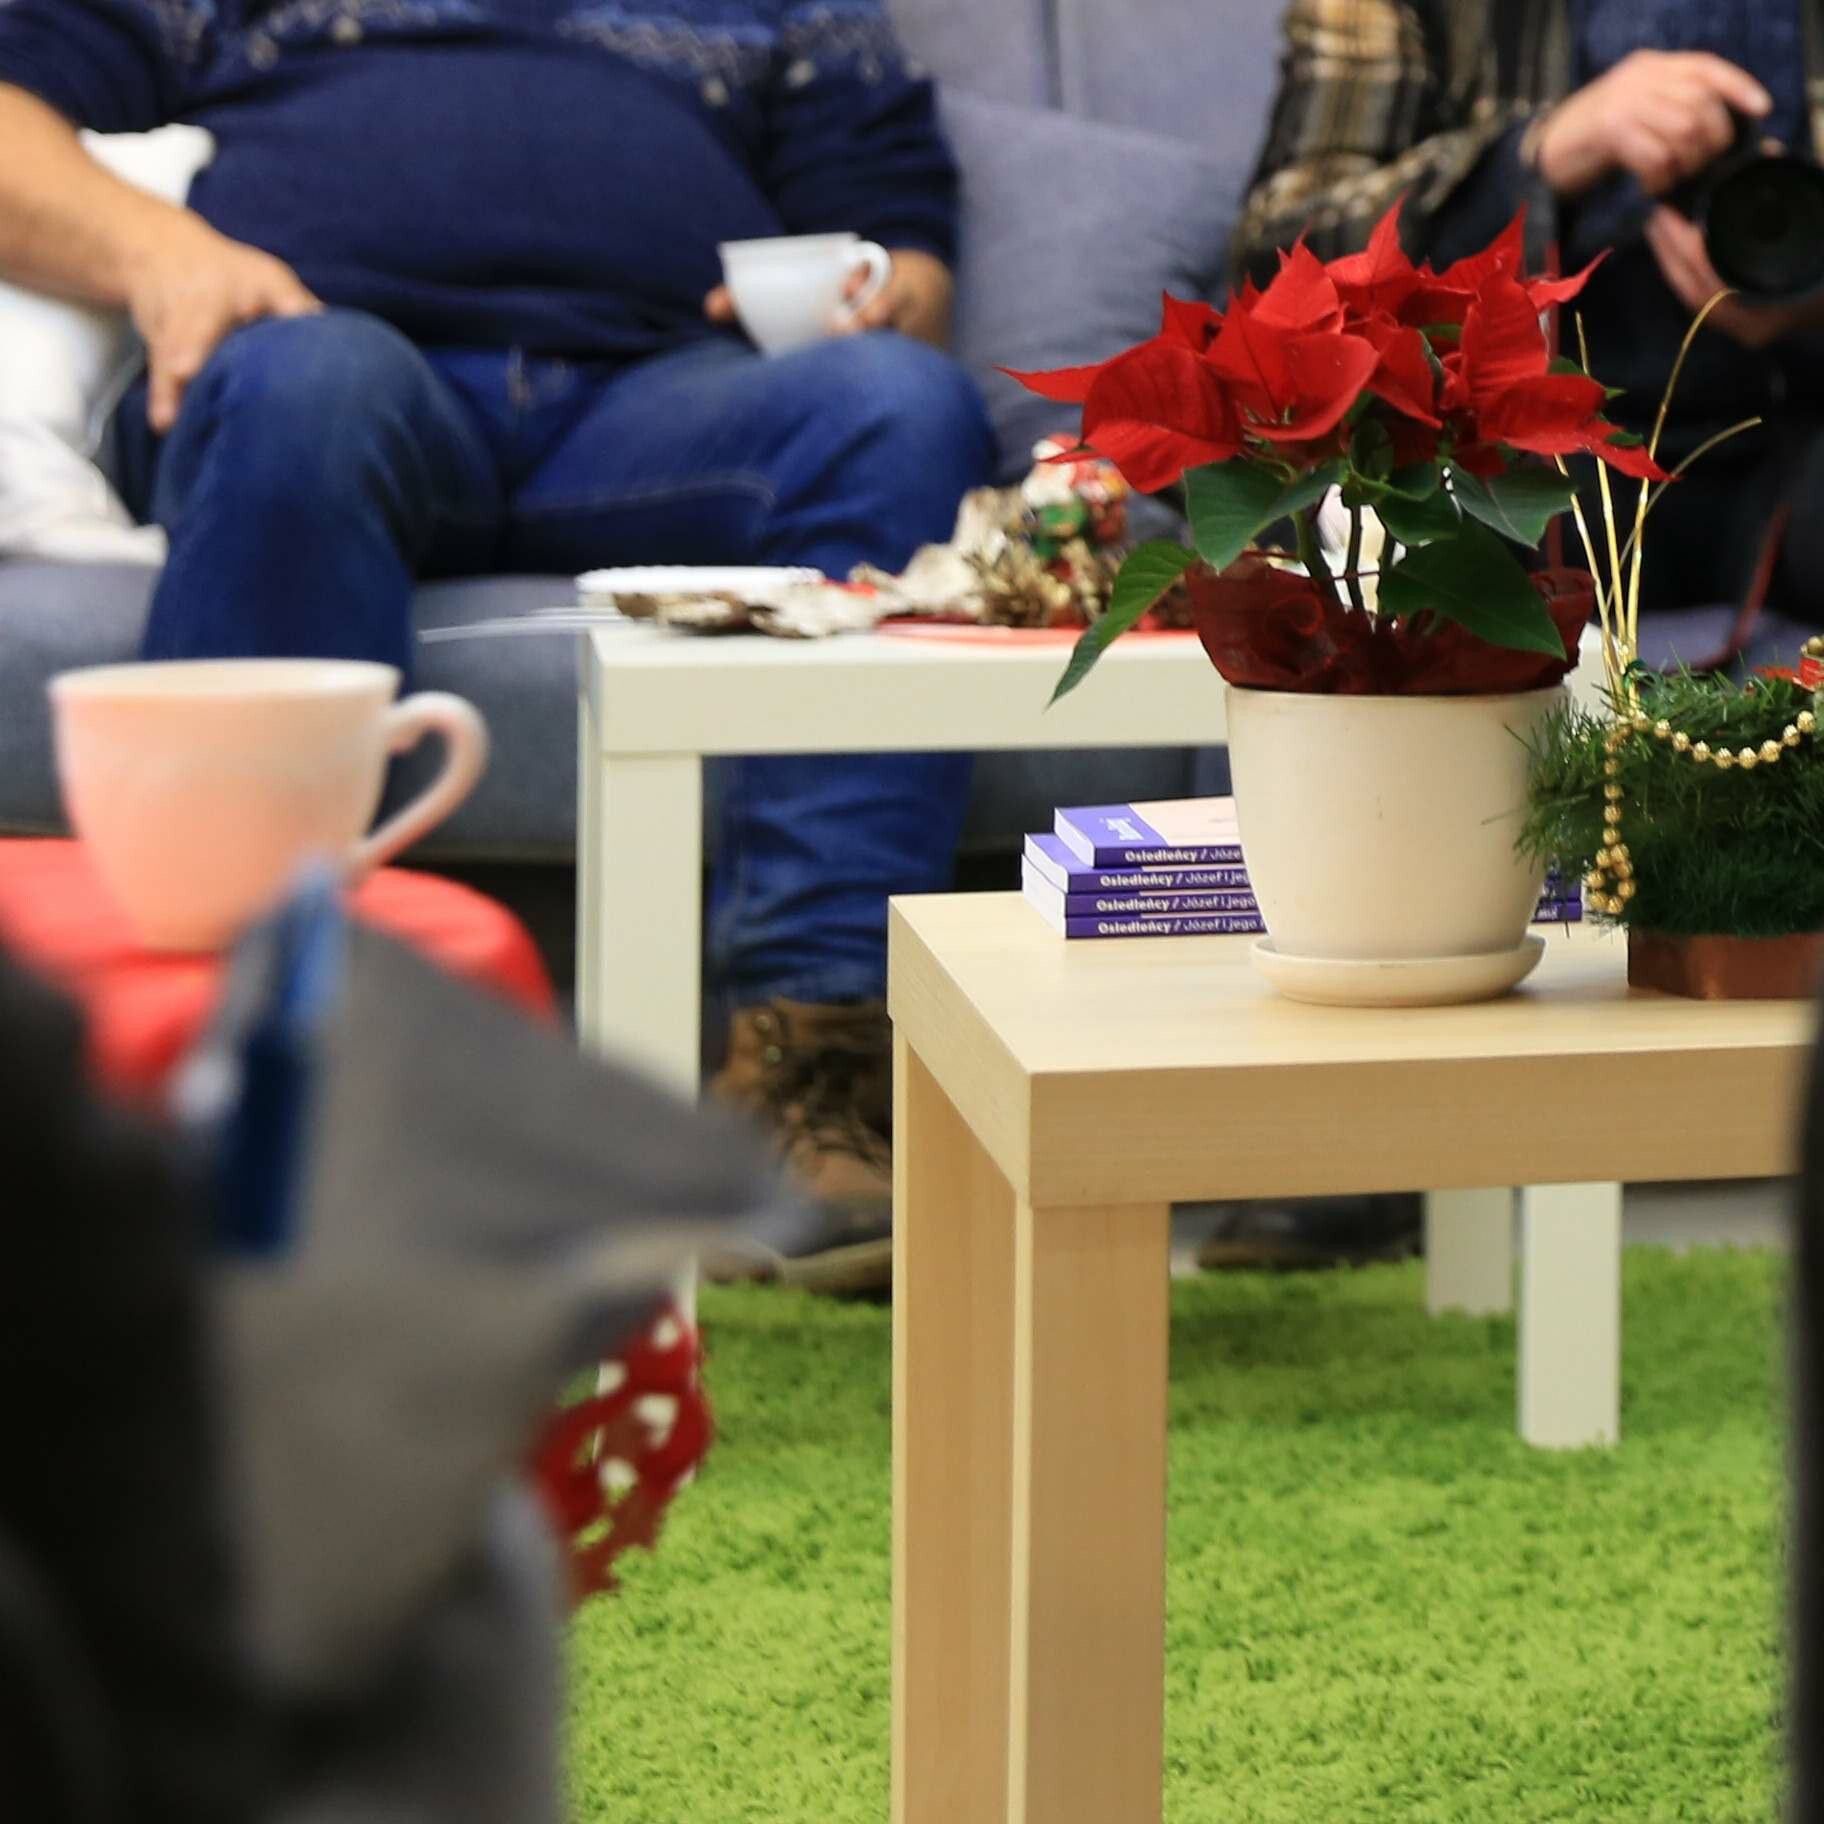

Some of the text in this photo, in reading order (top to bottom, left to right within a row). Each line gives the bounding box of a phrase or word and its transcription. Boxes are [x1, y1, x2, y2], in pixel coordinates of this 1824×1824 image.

[1125, 848, 1198, 862] Osiedleńcy
[1100, 873, 1173, 887] Osiedleńcy
[1185, 871, 1223, 884] Józef
[1096, 898, 1170, 912] Osiedleńcy
[1182, 896, 1219, 909] Józef
[1098, 921, 1171, 934] Osiedleńcy
[1183, 918, 1221, 932] Józef
[1228, 917, 1258, 933] jego
